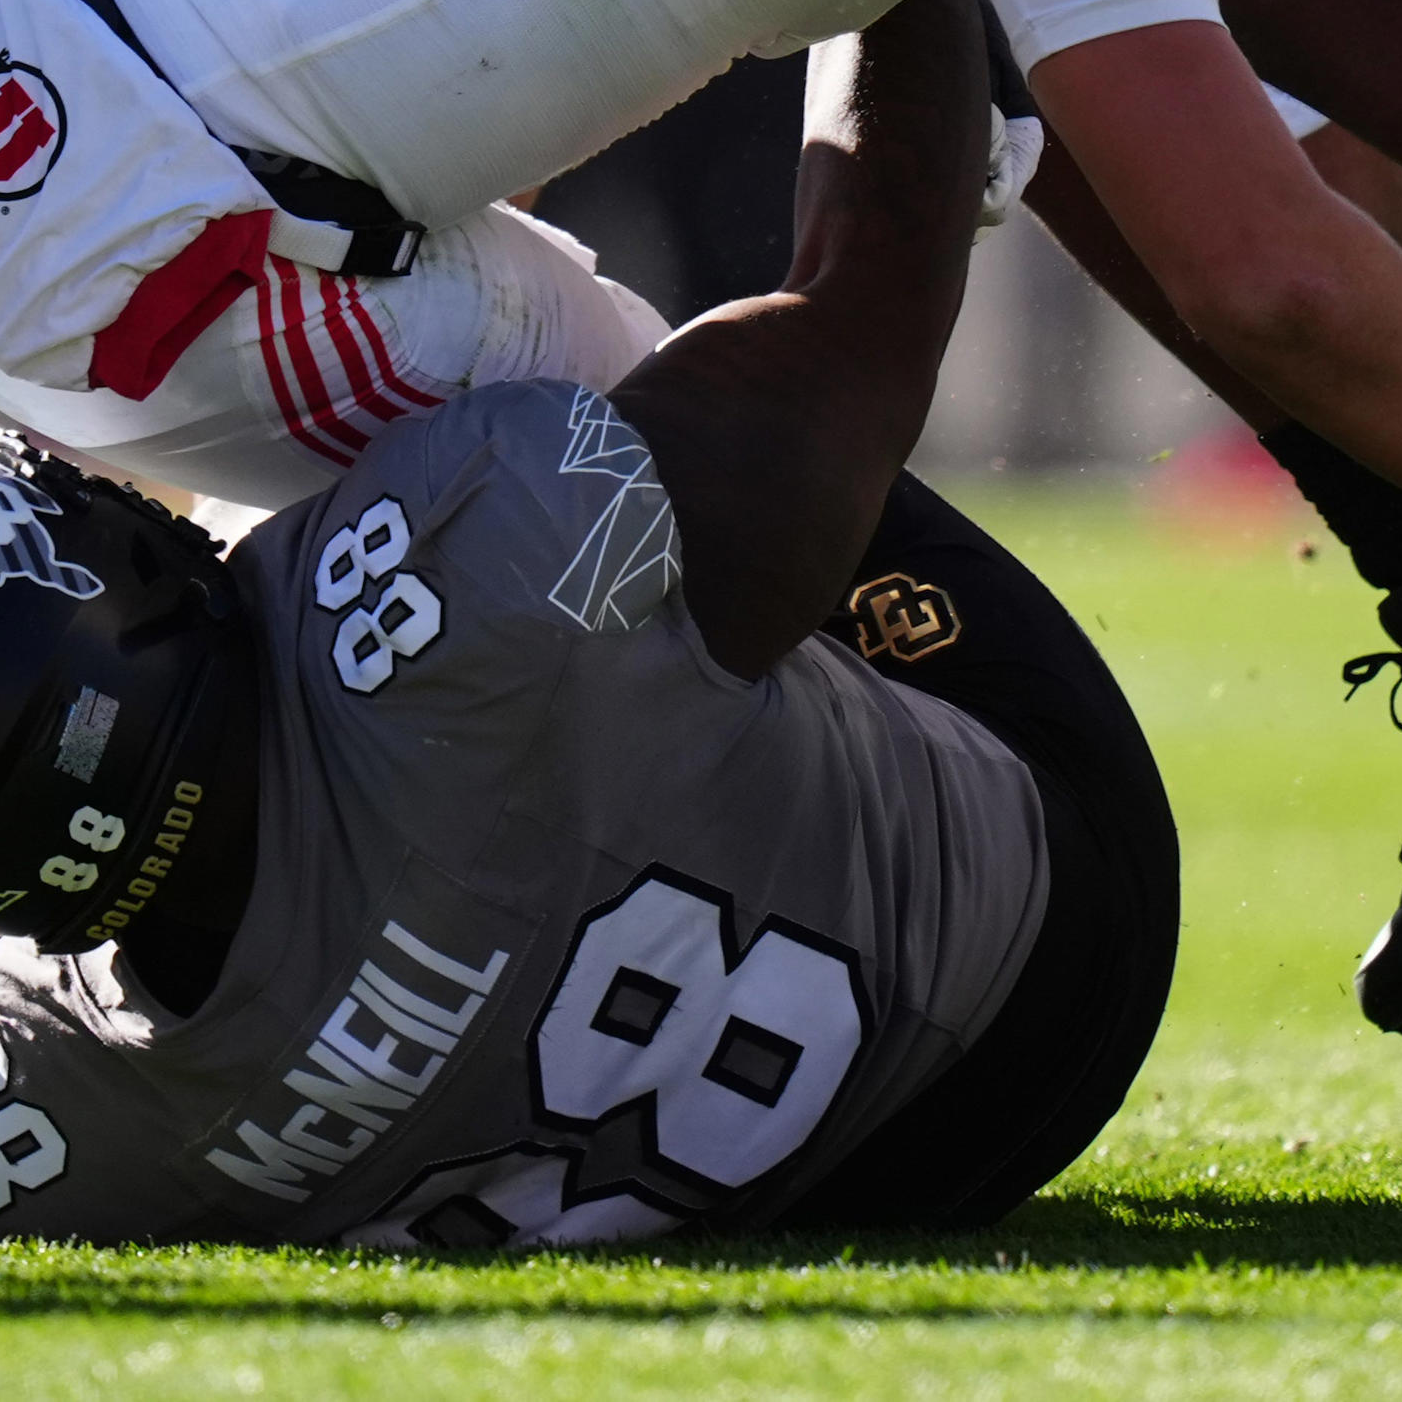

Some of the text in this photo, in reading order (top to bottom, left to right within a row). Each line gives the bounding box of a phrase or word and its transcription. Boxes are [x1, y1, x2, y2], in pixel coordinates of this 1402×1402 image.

[312, 493, 446, 698] 88
[39, 805, 127, 893] 88
[86, 780, 203, 940] COLORADO
